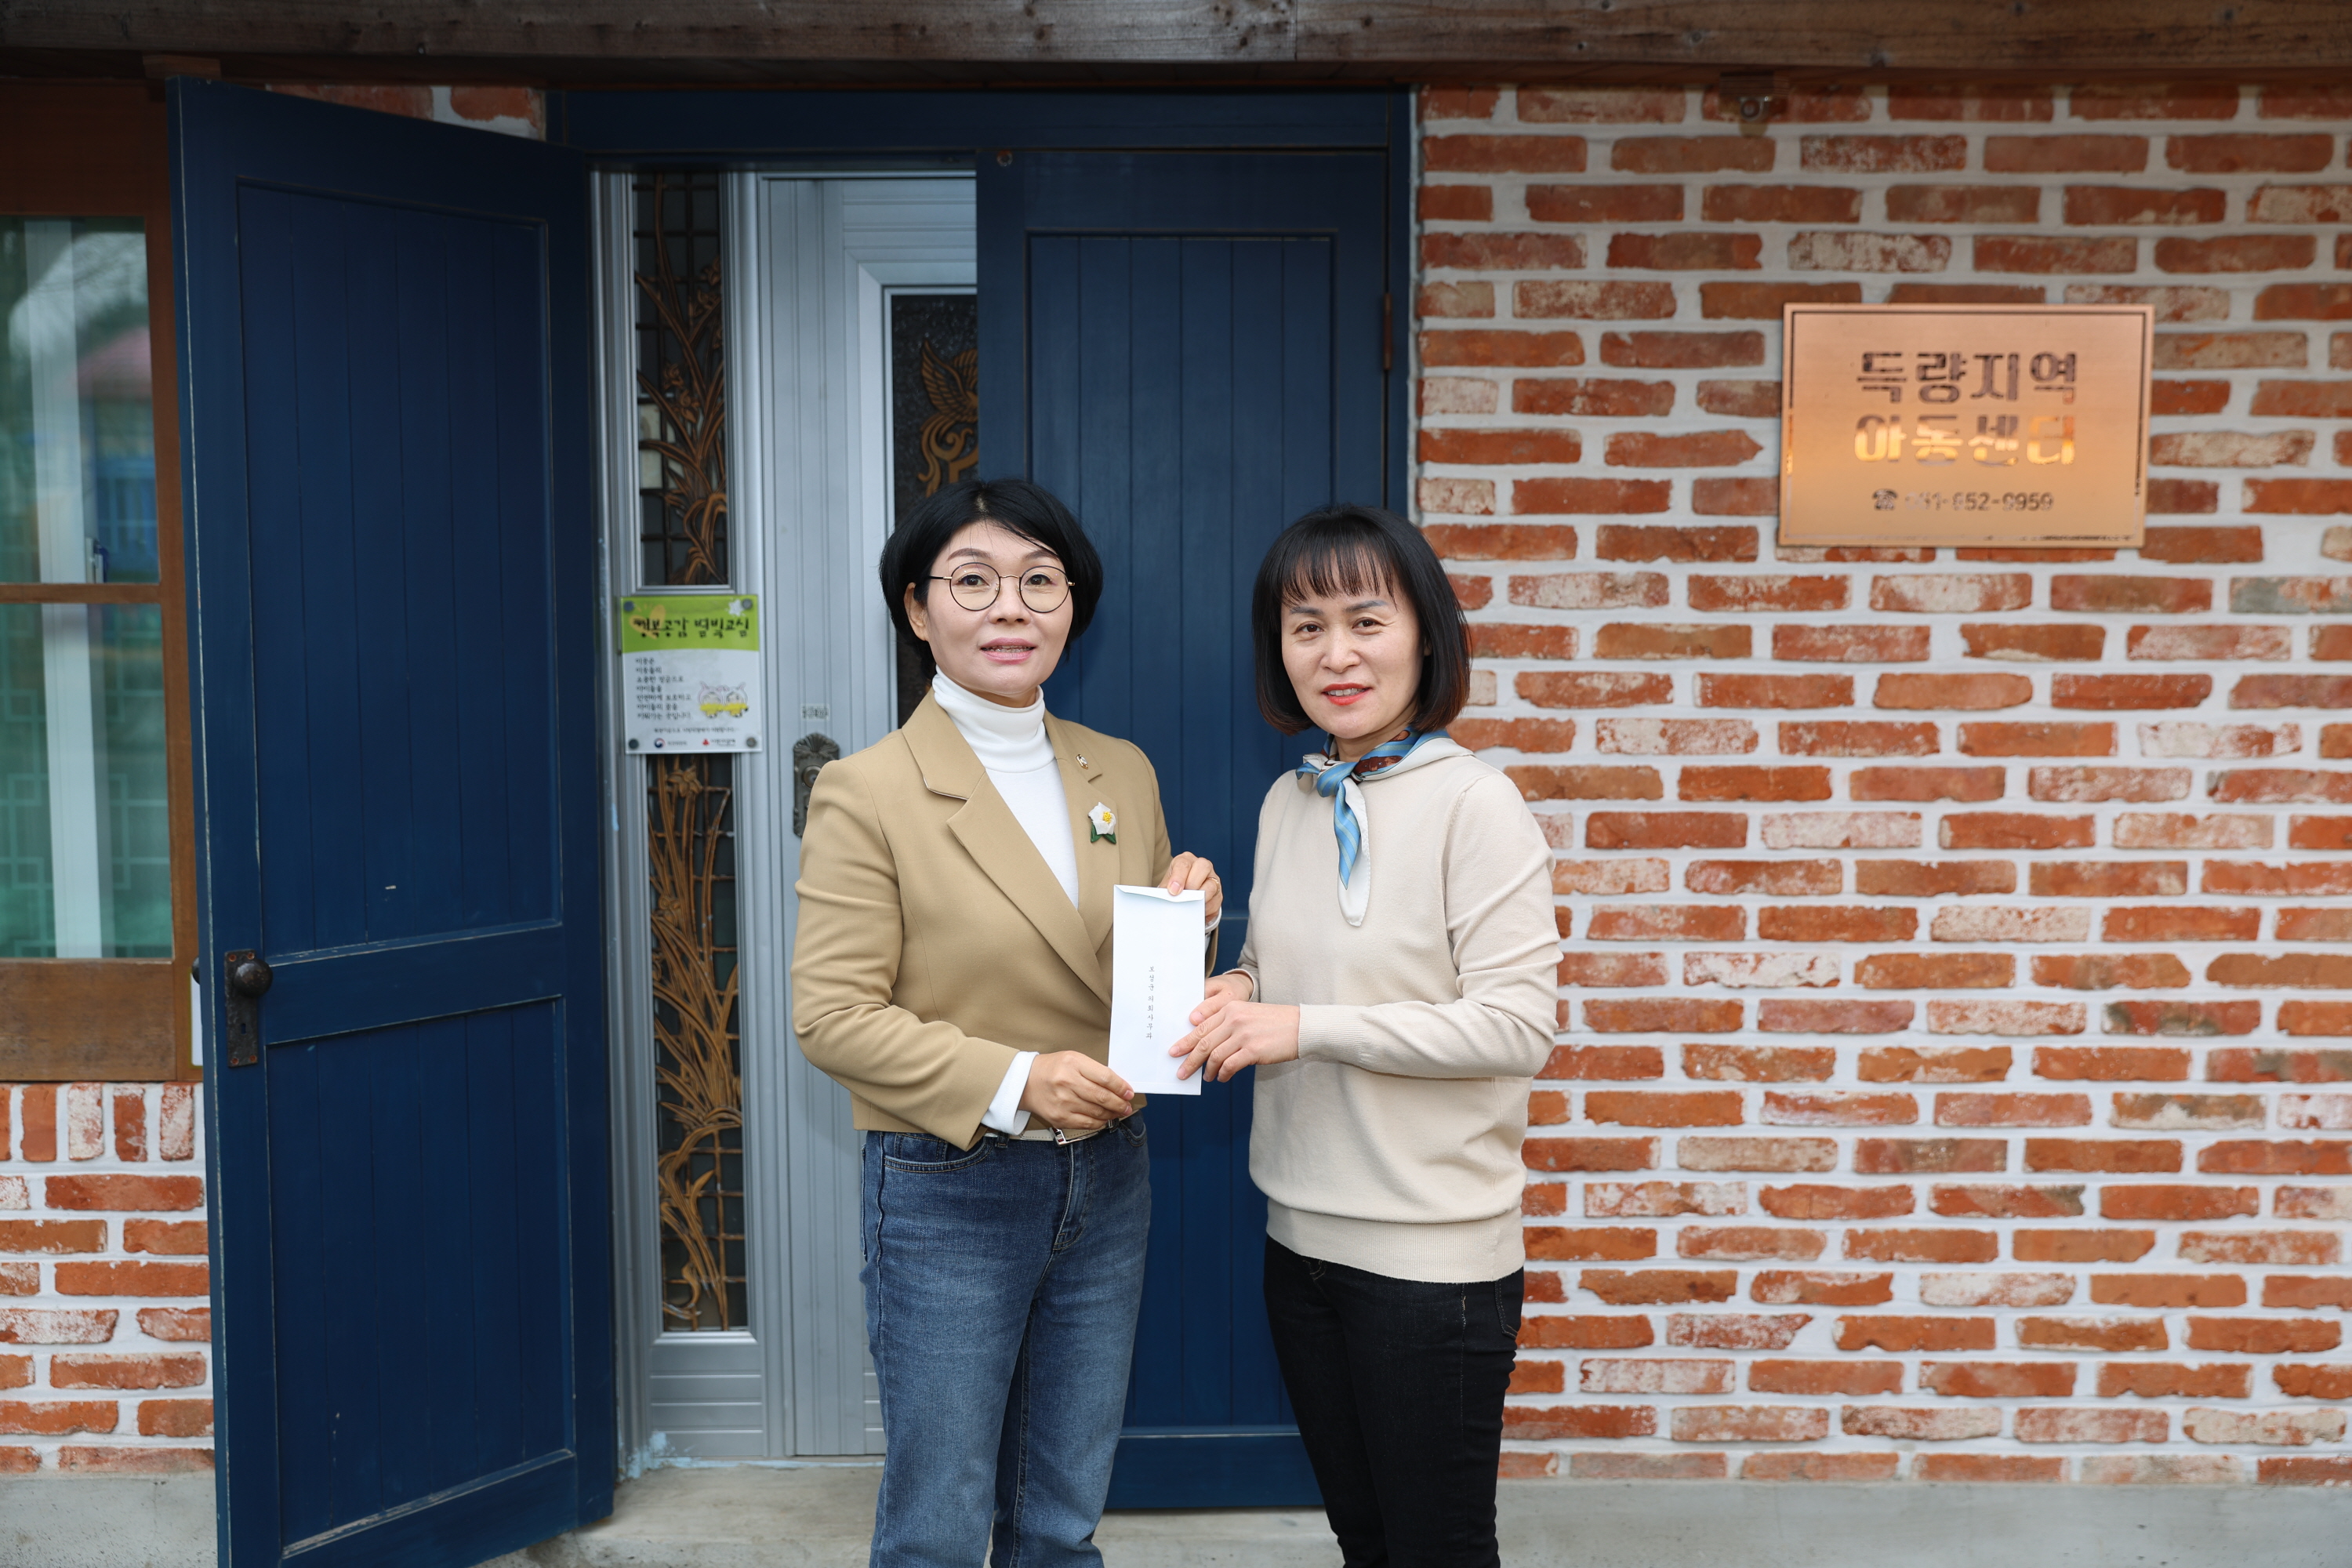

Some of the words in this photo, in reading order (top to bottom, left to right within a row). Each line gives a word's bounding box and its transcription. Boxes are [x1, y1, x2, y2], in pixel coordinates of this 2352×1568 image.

[1857, 352, 2077, 405] 득량지역
[1853, 414, 2076, 466] 아동센터
[633, 617, 689, 639] 행복공감
[1145, 995, 1154, 1040] 의회사무과
